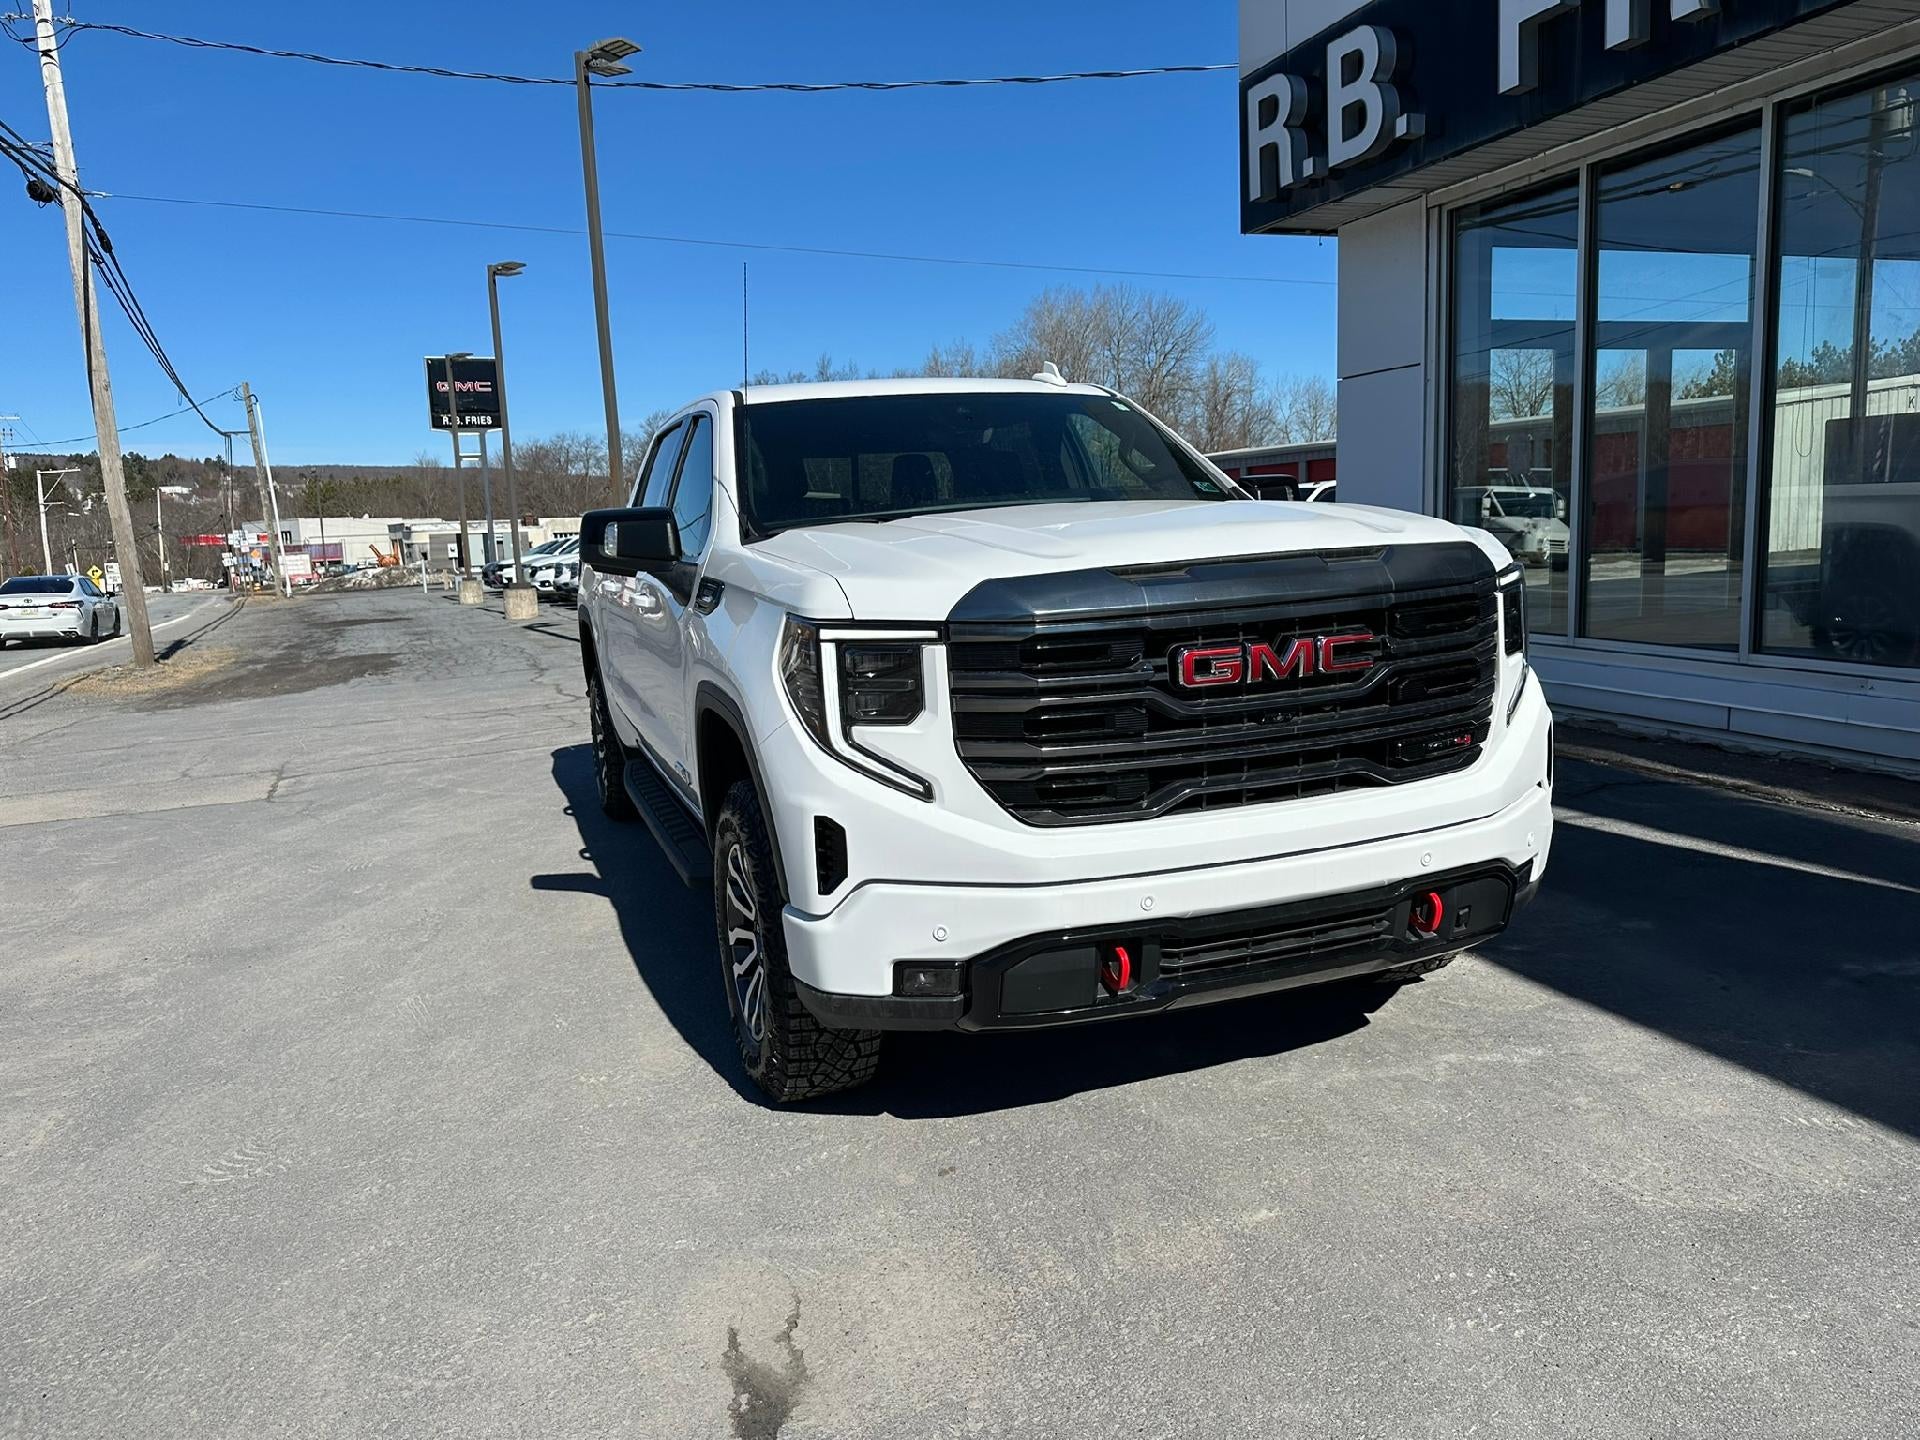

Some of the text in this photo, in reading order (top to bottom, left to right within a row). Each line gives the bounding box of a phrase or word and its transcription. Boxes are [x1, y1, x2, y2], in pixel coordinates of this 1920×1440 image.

[1246, 25, 1425, 202] R.B.
[465, 416, 492, 425] FRIES
[1179, 633, 1375, 688] GMC
